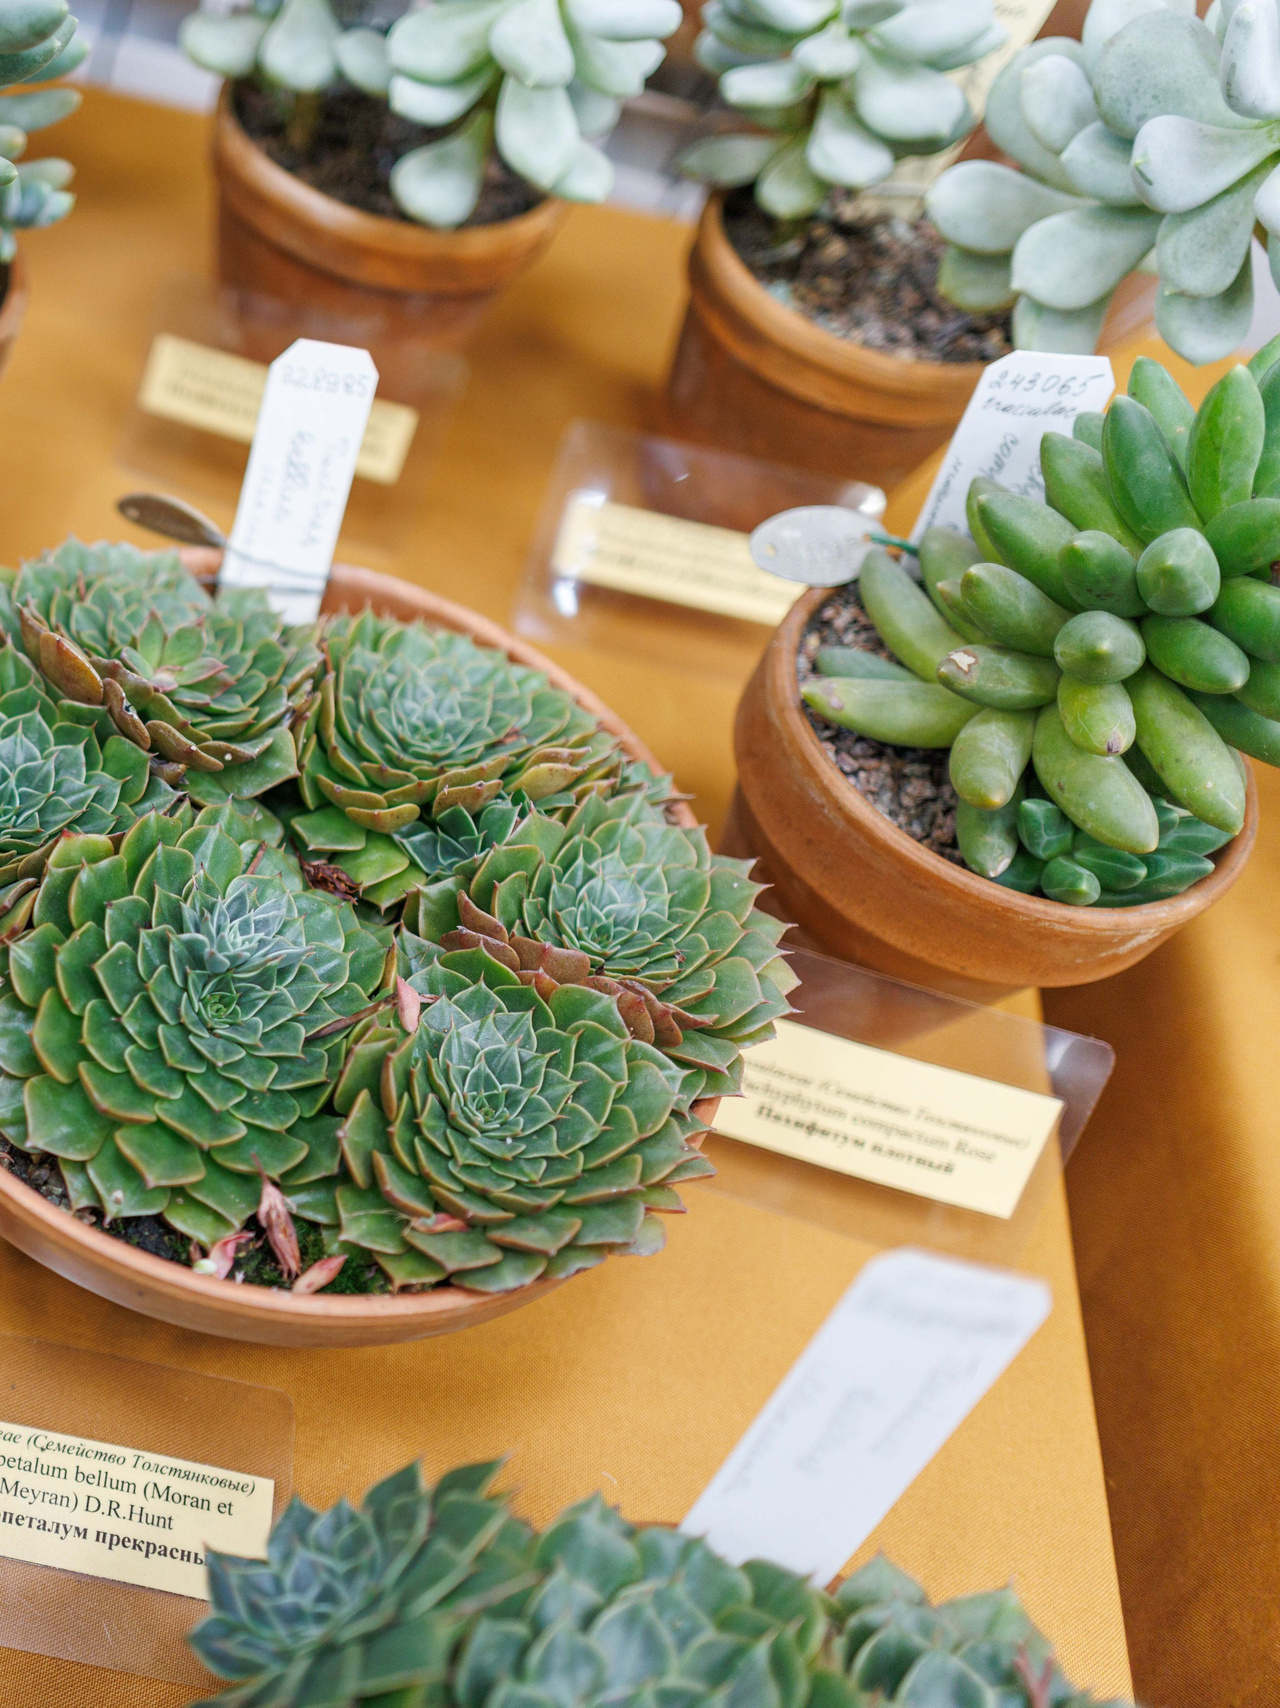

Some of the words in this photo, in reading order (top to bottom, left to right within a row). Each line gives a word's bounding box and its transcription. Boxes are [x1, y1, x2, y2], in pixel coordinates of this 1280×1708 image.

[26, 1432, 127, 1467] (Семейство
[131, 1454, 257, 1498] Толстянковые)
[73, 1465, 138, 1496] bellum
[142, 1481, 213, 1513] (Moran
[217, 1500, 234, 1517] et
[84, 1495, 174, 1531] D.R.Hunt
[94, 1530, 209, 1567] прекрасны
